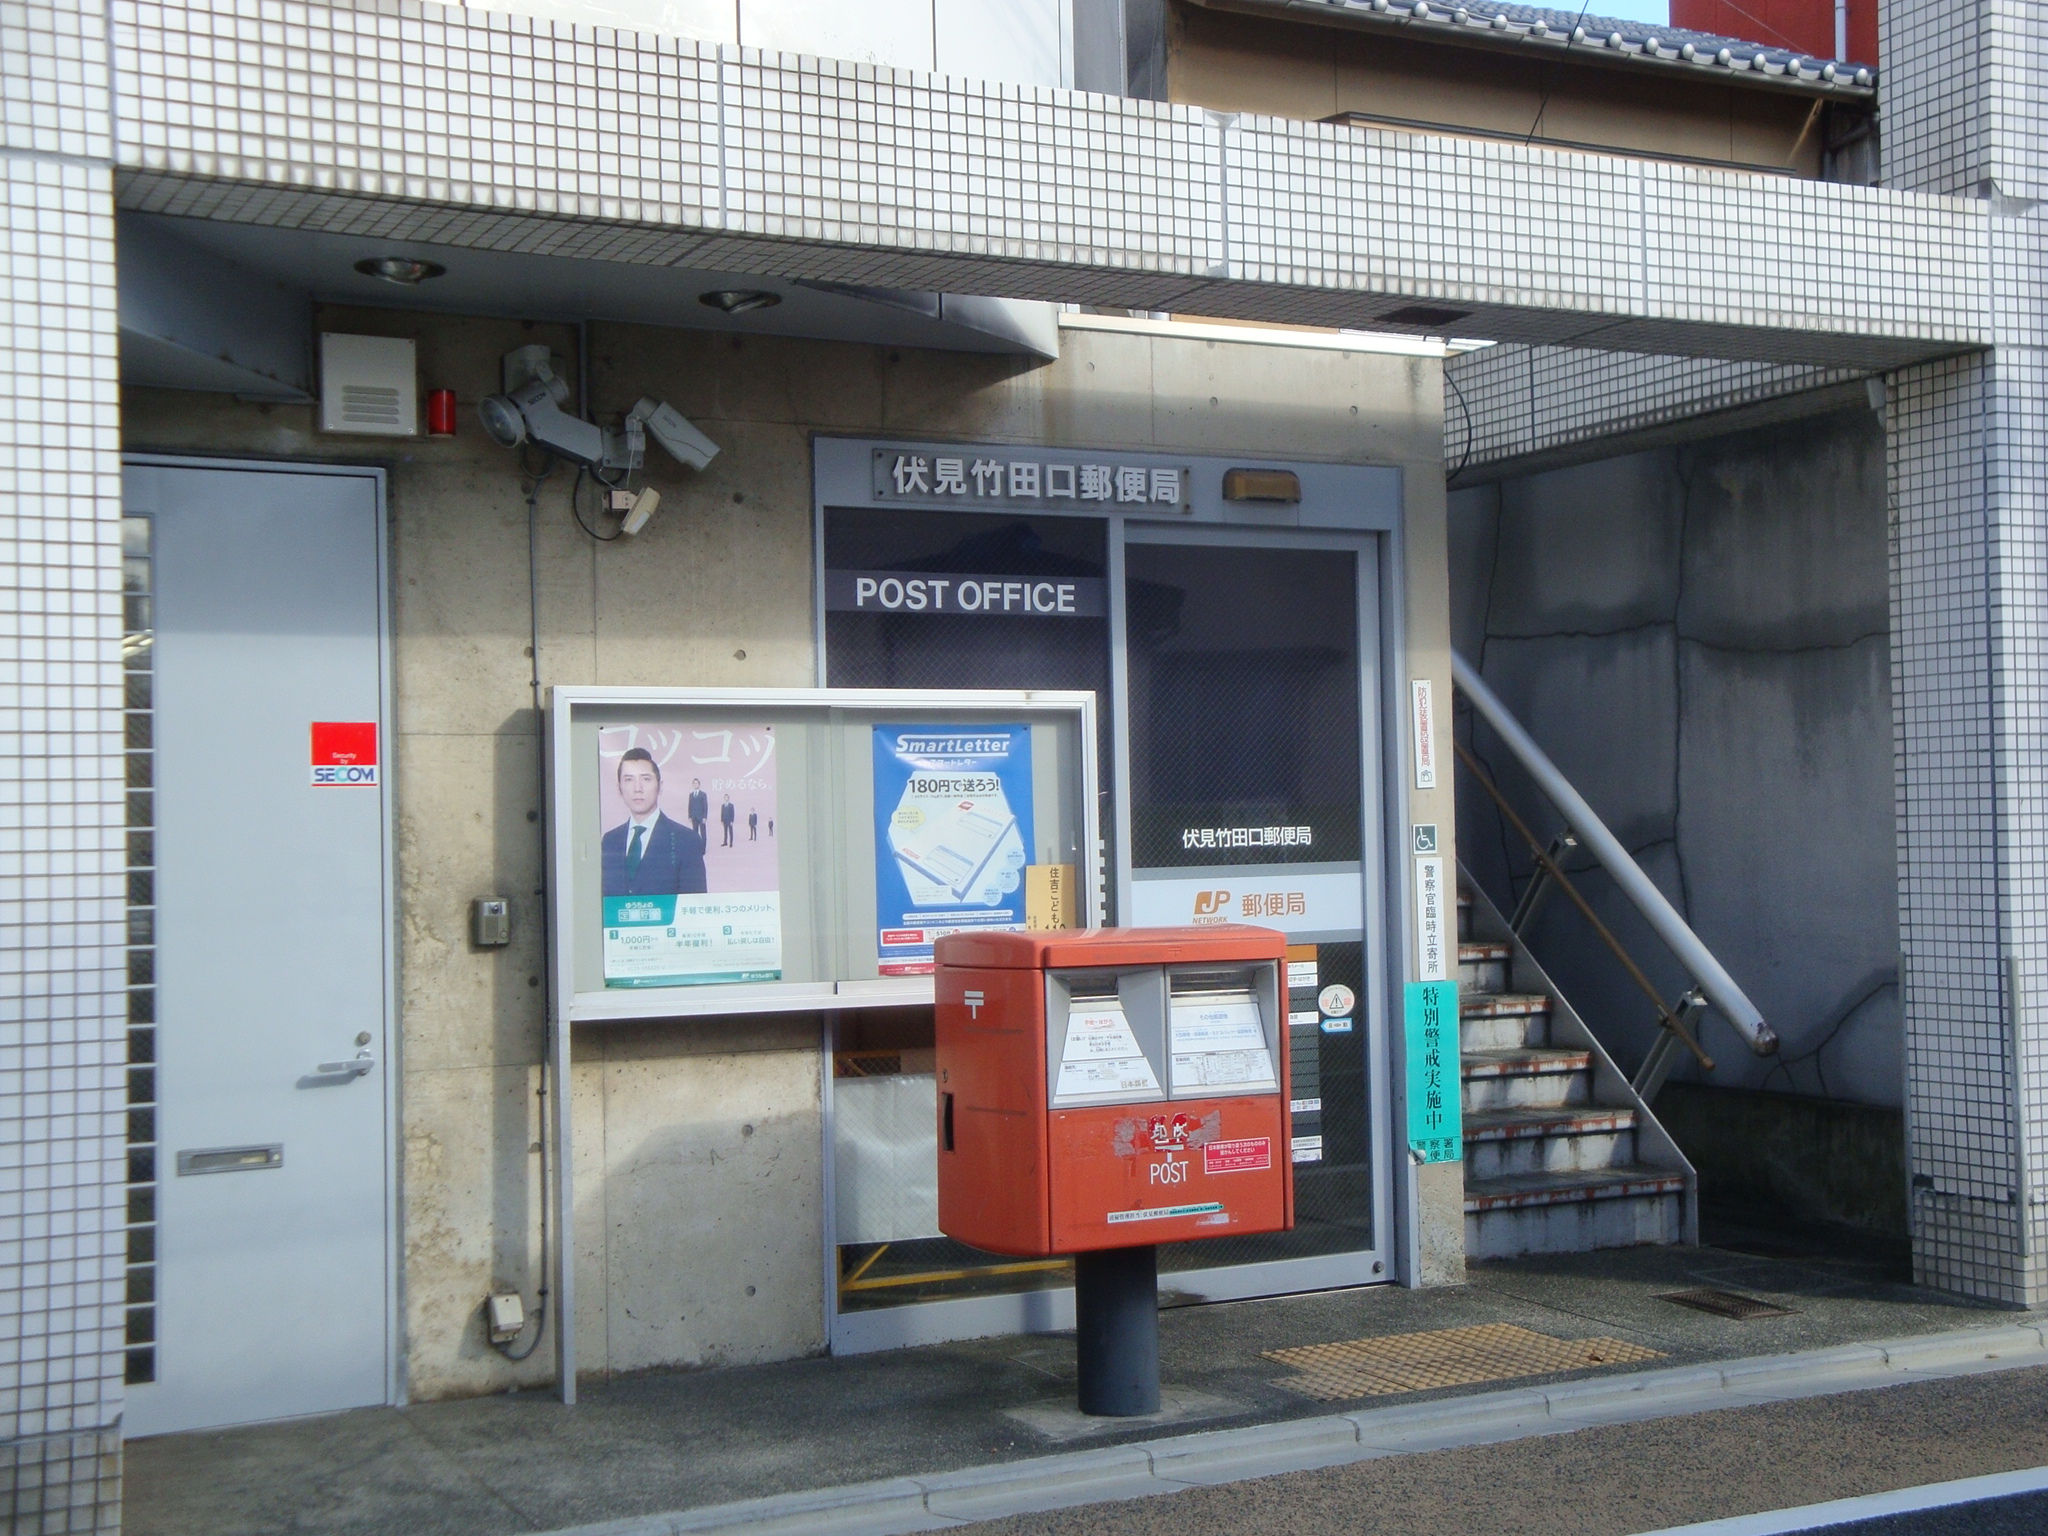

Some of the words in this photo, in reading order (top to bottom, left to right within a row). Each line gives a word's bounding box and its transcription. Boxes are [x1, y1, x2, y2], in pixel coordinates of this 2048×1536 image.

[892, 455, 1181, 504] 伏見竹田口郵便局
[856, 577, 949, 610] POST
[958, 580, 1076, 613] OFFICE
[896, 734, 1010, 753] SmartLetter
[314, 766, 375, 782] SECOM
[712, 778, 773, 791] 貯めるなら。
[1182, 826, 1312, 849] 伏見竹田口郵便局
[1241, 892, 1306, 918] 郵便局
[1192, 916, 1228, 925] NETWORK
[1424, 864, 1439, 974] 警察官臨時立寄所
[1422, 986, 1442, 1131] 特別警戒実施中
[1150, 1161, 1189, 1185] POST
